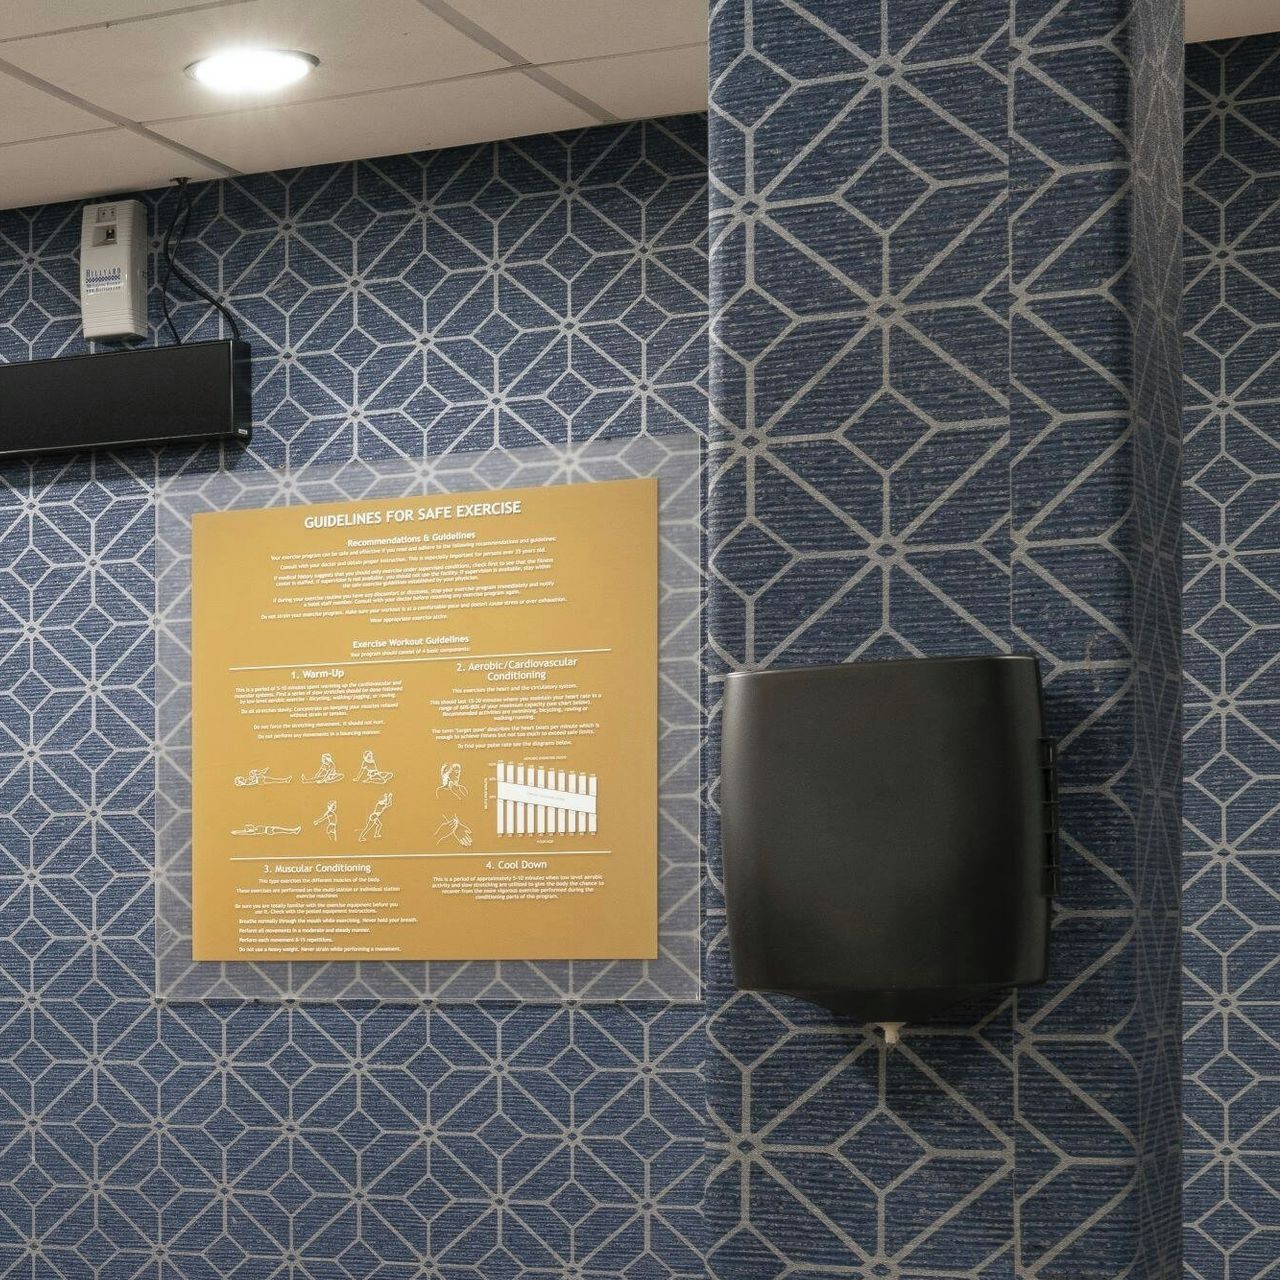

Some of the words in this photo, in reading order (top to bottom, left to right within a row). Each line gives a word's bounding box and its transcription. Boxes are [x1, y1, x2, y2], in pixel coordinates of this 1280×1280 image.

[304, 511, 381, 527] GUIDELINES
[385, 508, 413, 522] FOR
[417, 506, 451, 520] SAFE
[456, 501, 520, 517] EXERCISE
[347, 534, 421, 546] Recommendations
[422, 533, 429, 541] &
[431, 531, 474, 541] Guidelines
[352, 638, 387, 647] Exercise
[388, 637, 424, 646] Workout
[425, 635, 468, 644] Guidelines
[456, 662, 465, 671] 2.
[467, 657, 575, 670] Aerobic/Cardiovascular
[291, 670, 299, 679] 1.
[301, 668, 343, 680] Warm-Up
[487, 670, 545, 680] Conditioning
[263, 864, 271, 872] 3.
[274, 864, 312, 872] Muscular
[315, 863, 370, 874] Conditioning
[485, 860, 494, 869] 4.
[496, 860, 519, 869] Cool
[520, 859, 546, 868] Down
